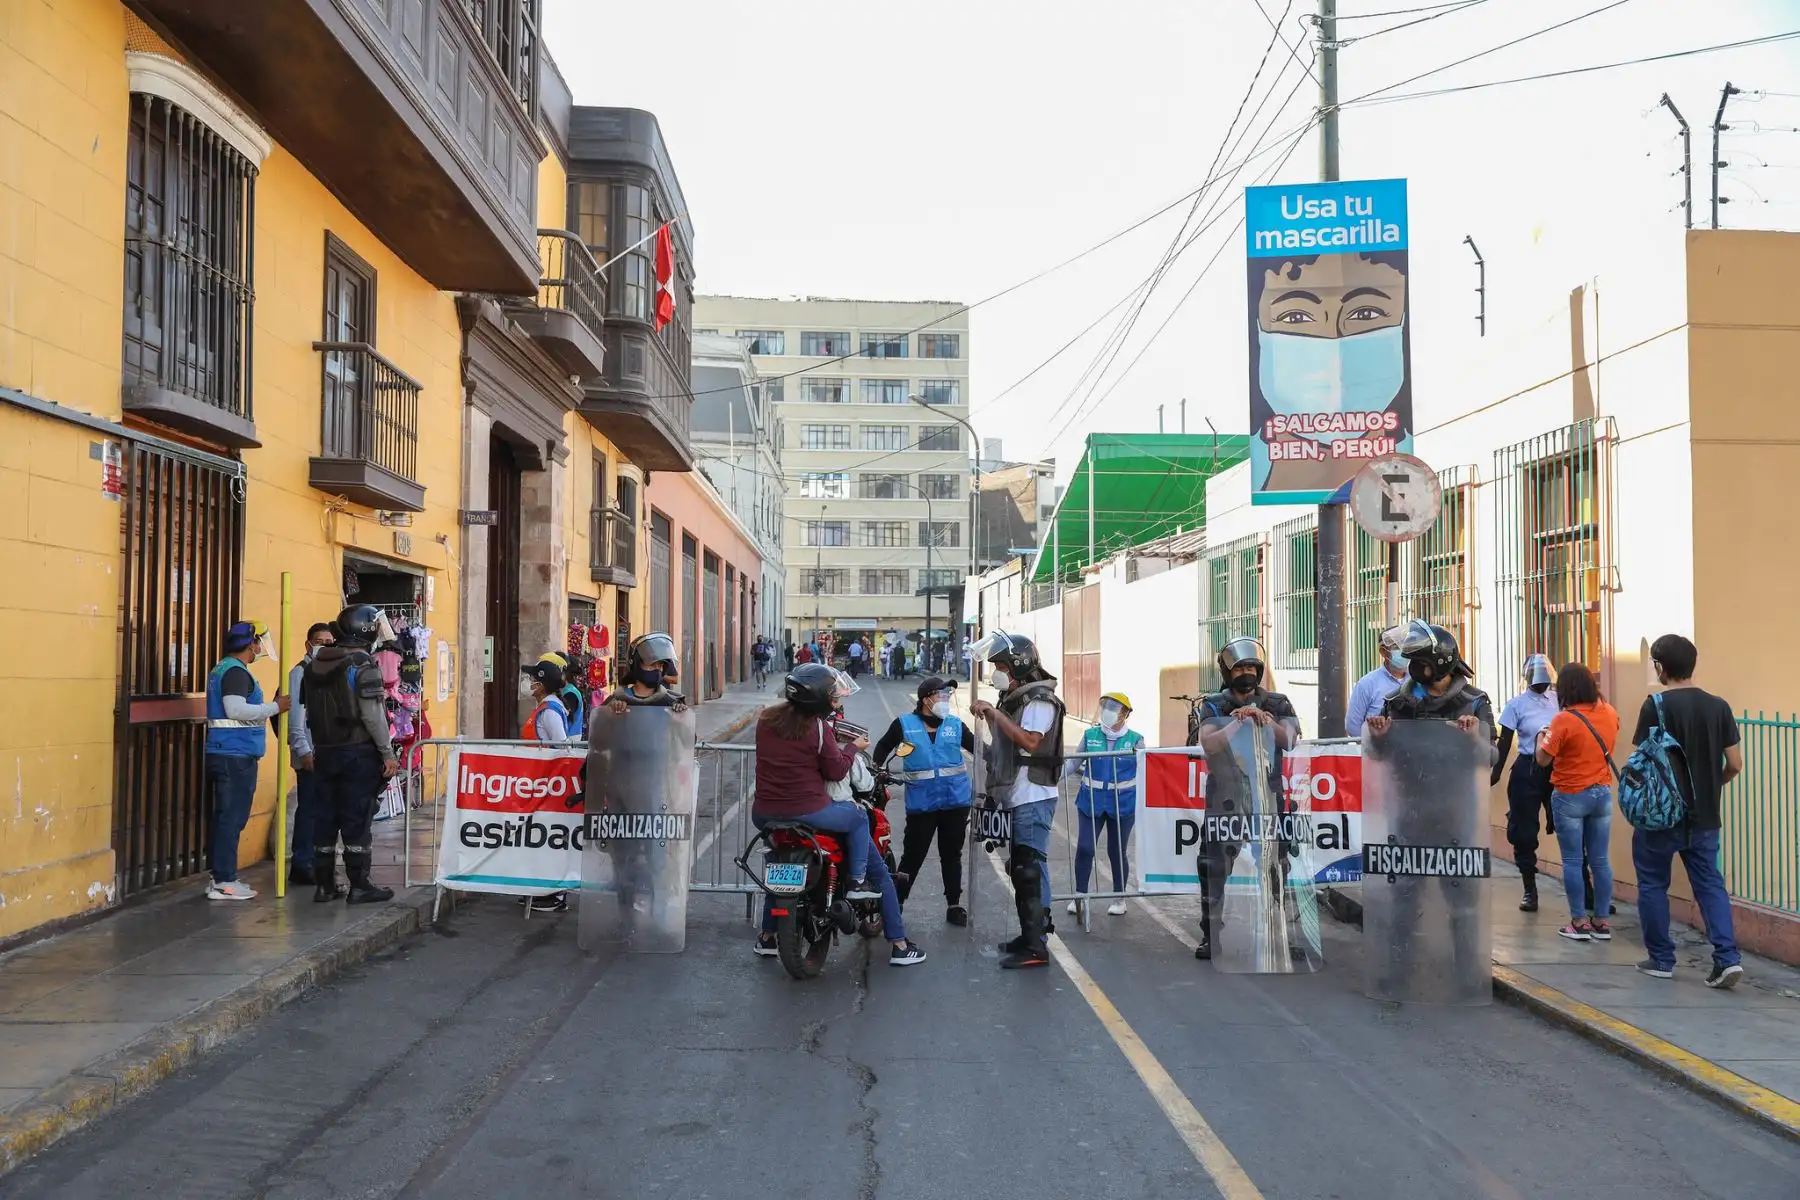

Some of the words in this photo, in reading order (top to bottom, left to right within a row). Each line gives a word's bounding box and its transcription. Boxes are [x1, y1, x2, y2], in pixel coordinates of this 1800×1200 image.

[1281, 194, 1337, 220] Usa
[1344, 195, 1373, 217] tu
[1255, 218, 1400, 249] mascarilla
[1266, 412, 1398, 438] ¡SALGAMOS
[1269, 440, 1326, 461] BIEN,
[1332, 437, 1396, 458] PERÚ!
[460, 765, 567, 803] Ingreso
[590, 814, 685, 839] FISCALIZACION
[1207, 815, 1312, 842] FISCALIZACION
[1368, 845, 1484, 876] FISCALIZACION
